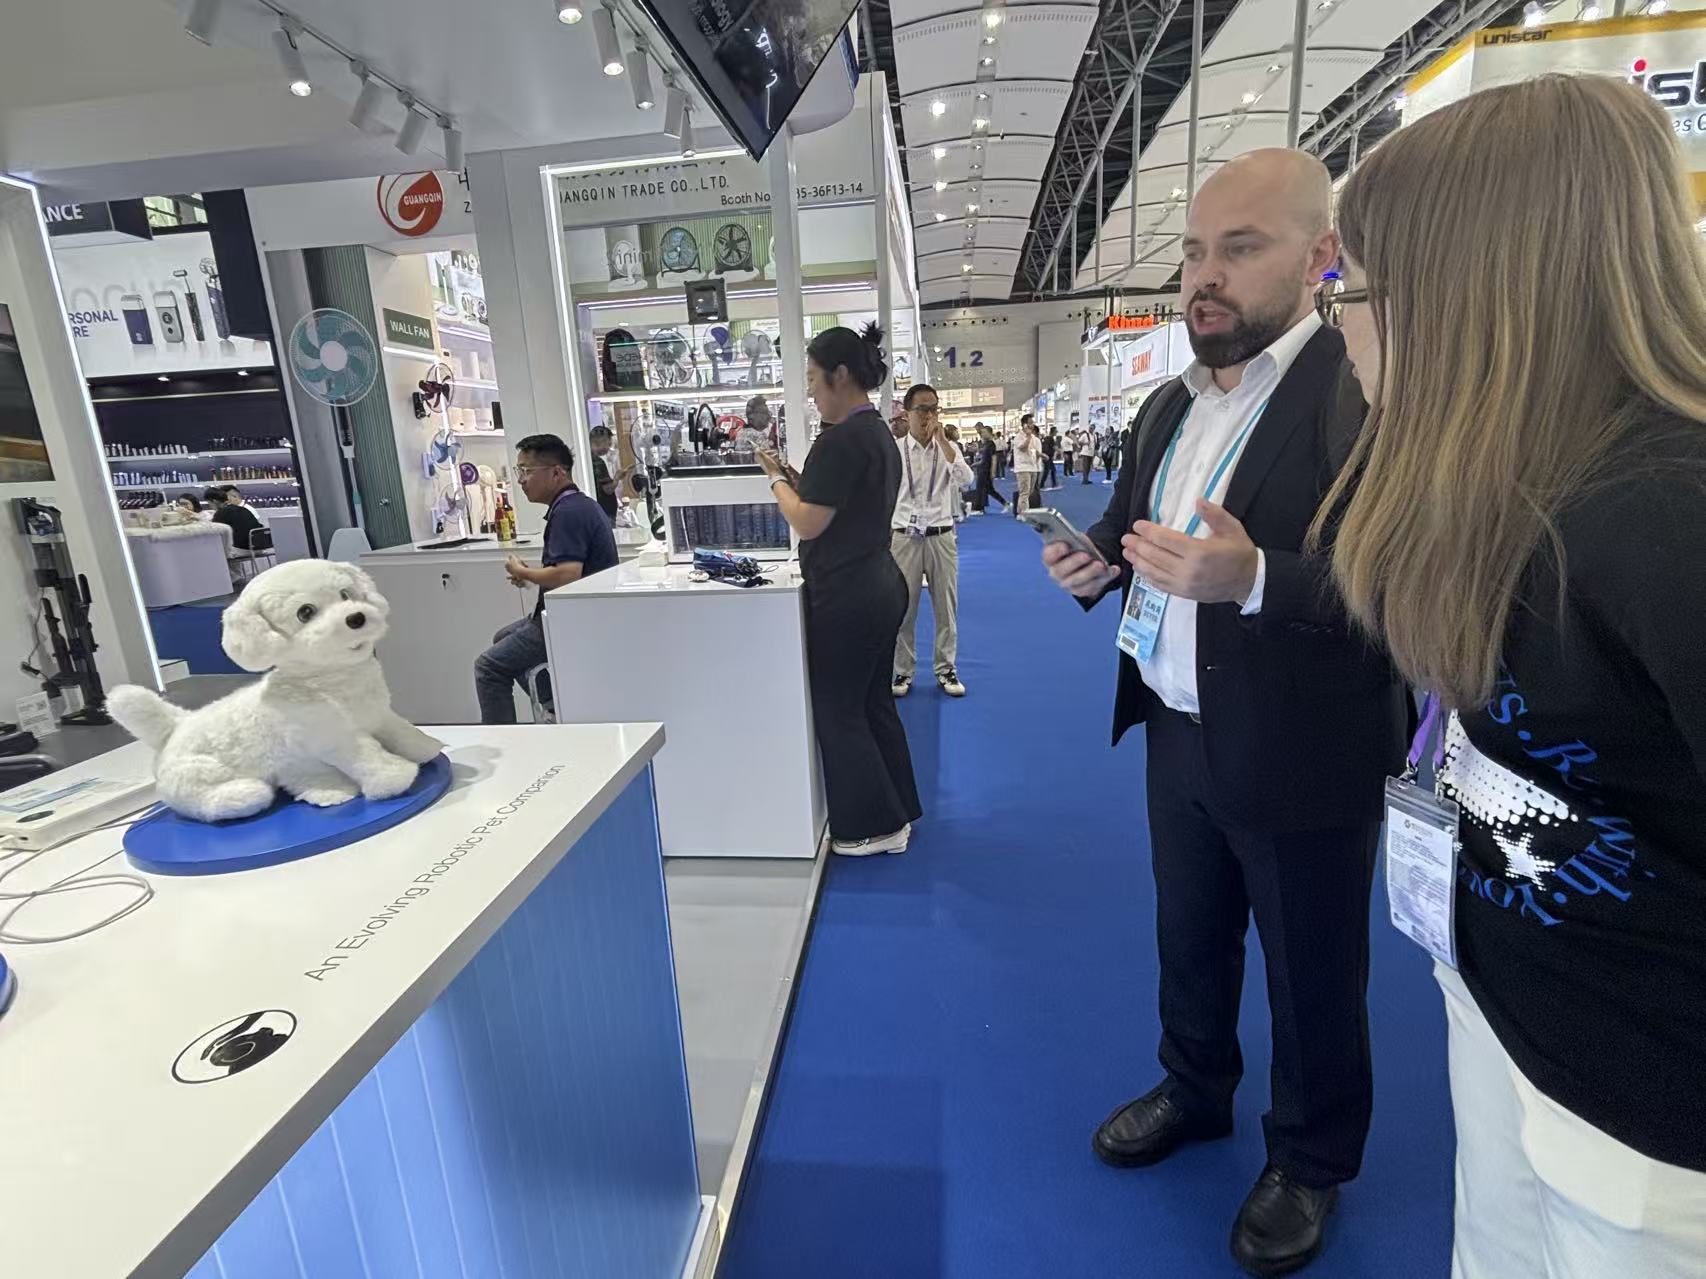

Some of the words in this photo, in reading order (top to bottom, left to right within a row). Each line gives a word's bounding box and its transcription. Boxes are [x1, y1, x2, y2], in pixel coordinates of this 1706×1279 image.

[1483, 29, 1552, 44] unistar
[403, 192, 442, 206] GUANGQIN
[622, 181, 665, 199] TRADE
[721, 193, 752, 206] Booth
[390, 320, 414, 335] WALL
[414, 325, 430, 339] FAN
[944, 346, 984, 368] 1.2
[303, 955, 348, 981] An
[335, 886, 430, 949] Evolving
[413, 836, 483, 883] Robotic
[472, 816, 508, 835] Pet
[497, 764, 566, 815] Companion
